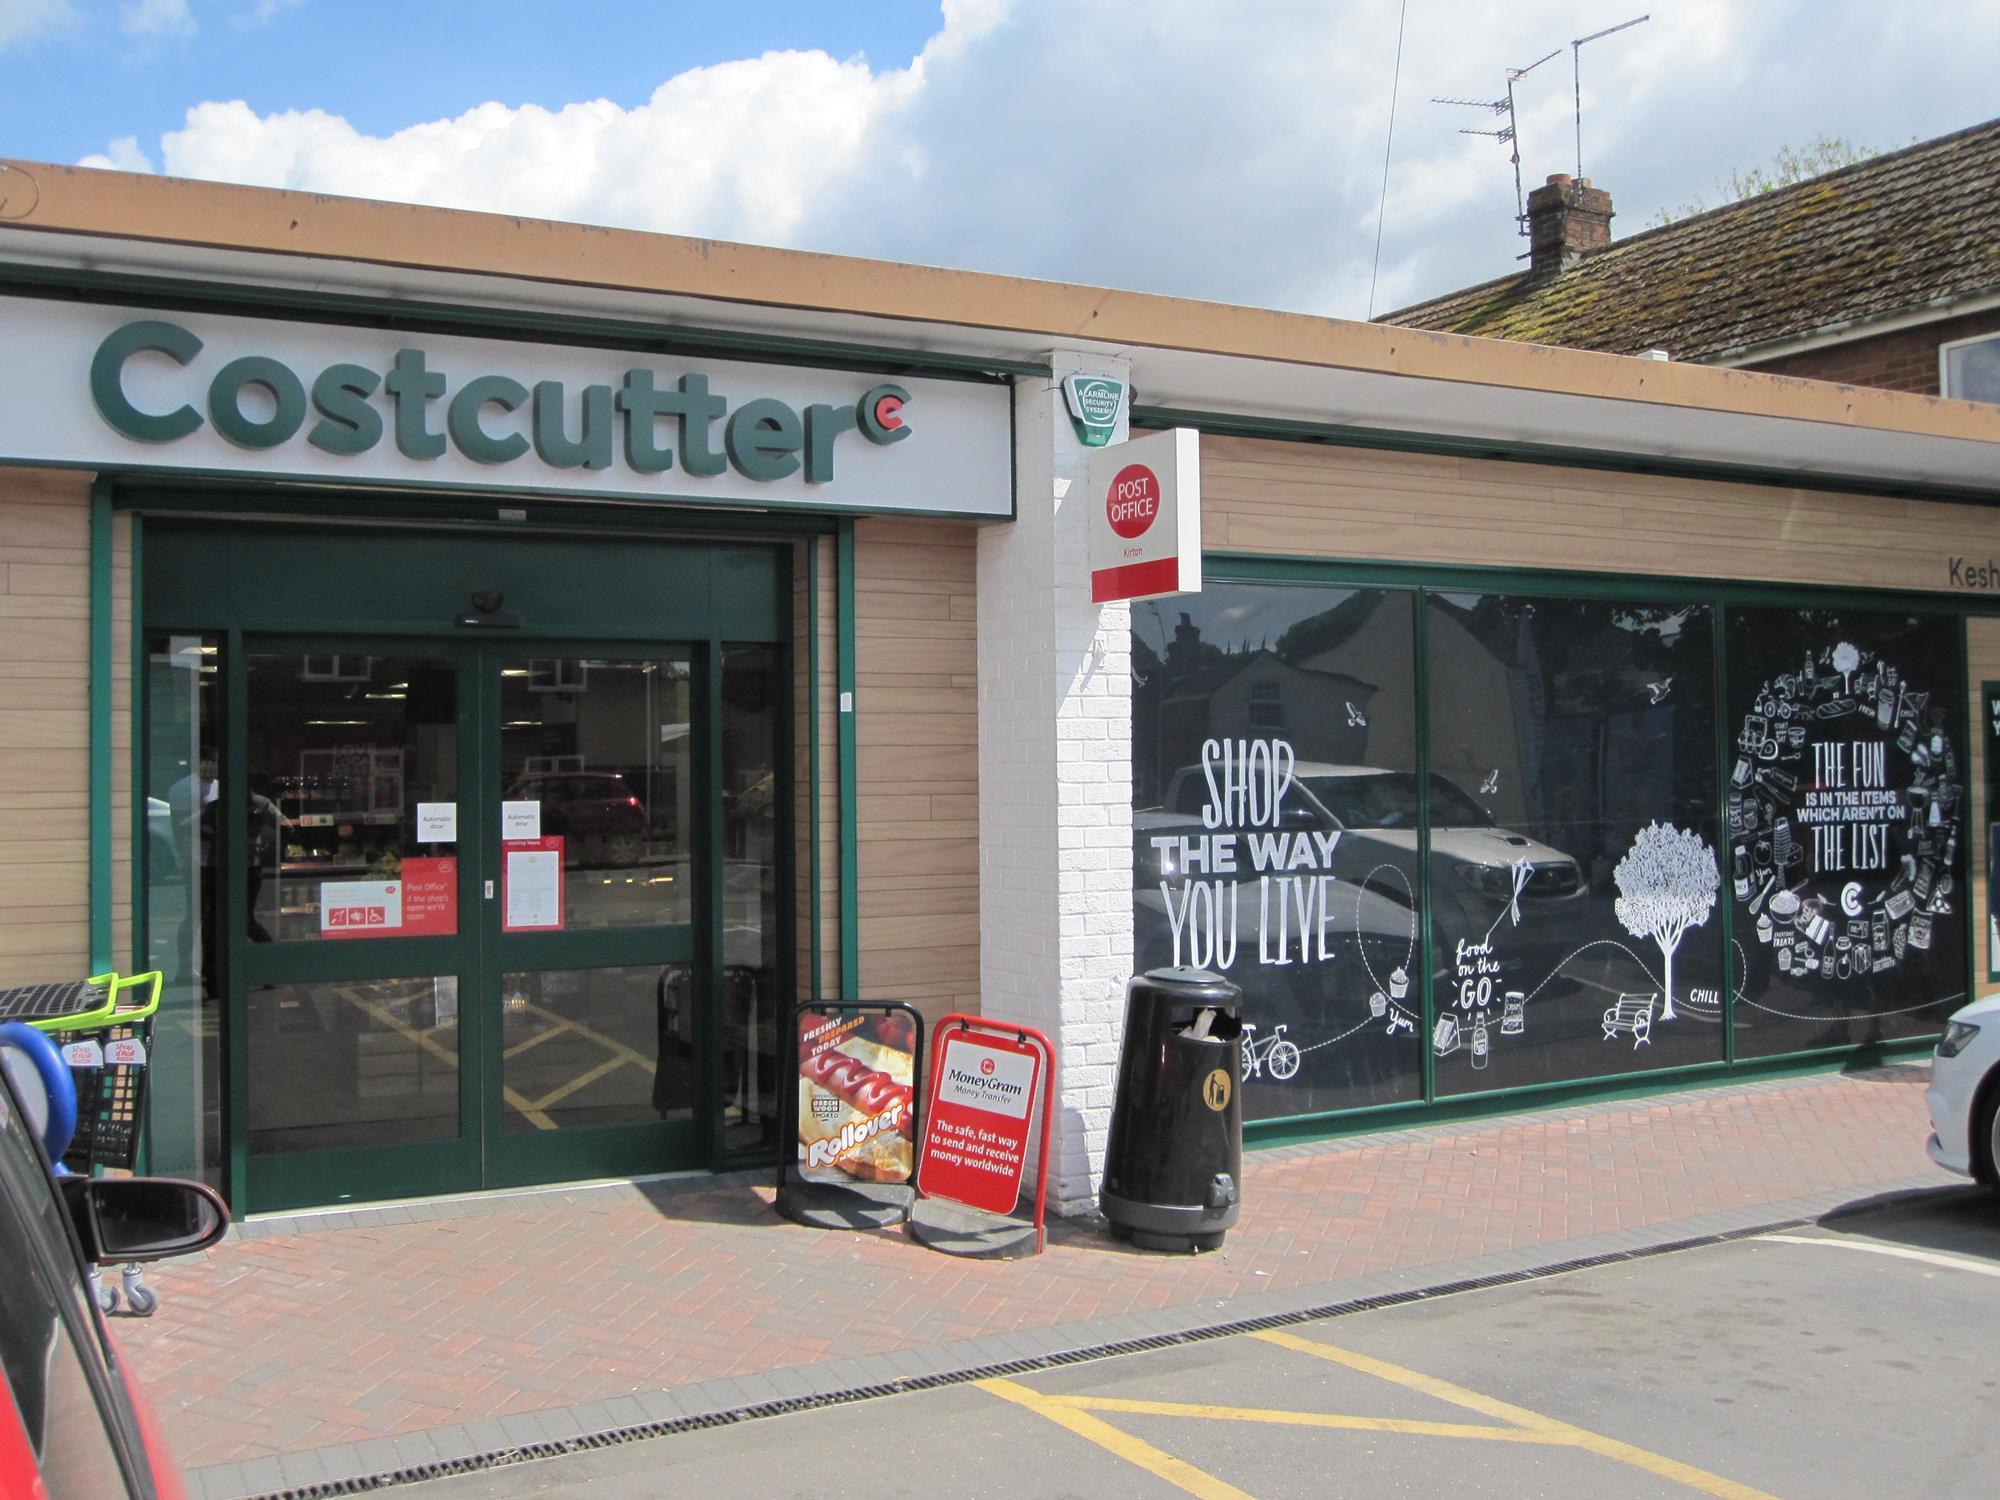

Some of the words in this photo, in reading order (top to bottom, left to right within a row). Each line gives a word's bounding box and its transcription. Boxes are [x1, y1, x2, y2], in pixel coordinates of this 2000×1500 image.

[90, 320, 857, 484] Costcutter
[1078, 389, 1120, 401] ALARMLINE
[1085, 398, 1114, 407] SECURITY
[1086, 406, 1113, 414] SYSTEMS
[1118, 477, 1149, 501] POST
[1111, 497, 1153, 522] OFFICE
[1123, 546, 1143, 559] Kirton
[1948, 556, 2000, 588] Kesh
[1811, 741, 1846, 789] THE
[1853, 741, 1885, 788] FUN
[1201, 738, 1294, 830] SHOP
[1806, 792, 1818, 806] IS
[1820, 792, 1833, 806] IN
[1834, 791, 1859, 806] THE
[1861, 790, 1897, 805] ITEMS
[1796, 807, 1840, 822] WHICH
[1842, 806, 1885, 821] AREN'T
[1887, 805, 1905, 820] ON
[1151, 834, 1237, 876] THE
[1247, 831, 1342, 872] WAY
[1811, 824, 1846, 873] THE
[1852, 823, 1890, 870] LIST
[407, 882, 422, 891] Post
[1159, 879, 1238, 970] YOU
[1259, 875, 1336, 965] LIVE
[1456, 938, 1493, 966] food
[1773, 938, 1795, 948] TREATS
[1458, 965, 1475, 977] on
[1477, 956, 1500, 974] the
[1460, 977, 1492, 1009] GO
[1690, 988, 1719, 1004] CHILL
[803, 1016, 843, 1043] FRESHLY
[818, 1016, 865, 1045] PREPARED
[811, 1036, 842, 1057] TODAY
[948, 1068, 1022, 1096] MoneyGram
[953, 1084, 980, 1098] Money
[981, 1090, 1012, 1105] Transfer
[808, 1103, 904, 1169] Rollover
[930, 1133, 941, 1144] to
[942, 1136, 965, 1150] send
[966, 1141, 984, 1155] and
[985, 1147, 1020, 1164] receive
[936, 1119, 953, 1133] The
[954, 1123, 976, 1140] safe,
[978, 1129, 996, 1143] fast
[998, 1136, 1018, 1151] way
[930, 1150, 962, 1167] money
[964, 1158, 1014, 1177] worldwide
